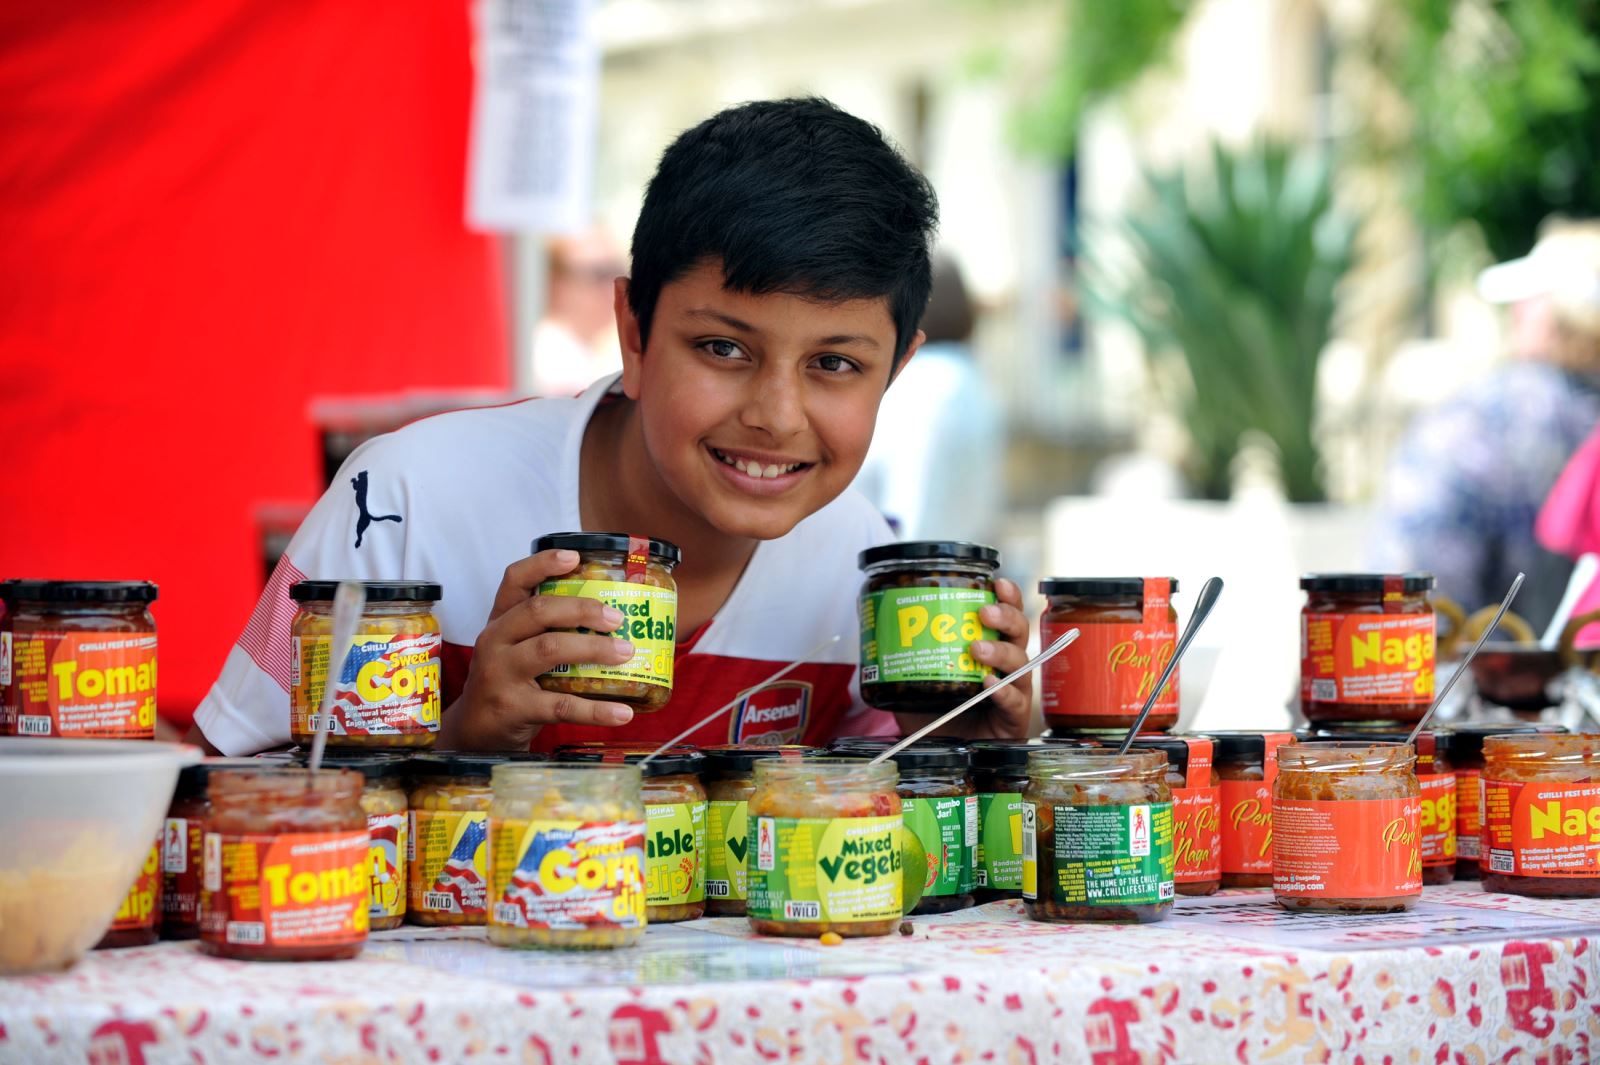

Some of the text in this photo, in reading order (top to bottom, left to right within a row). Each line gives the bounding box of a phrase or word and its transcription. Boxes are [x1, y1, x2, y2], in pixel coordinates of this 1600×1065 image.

[604, 599, 650, 617] ixed
[898, 605, 983, 647] Pea
[361, 643, 387, 653] CHILLI
[1351, 631, 1433, 670] Naga
[389, 650, 430, 669] Sweet
[356, 661, 440, 702] Corn
[744, 698, 801, 724] Arsenal
[24, 721, 49, 733] MILD
[345, 719, 366, 729] Enjoy
[367, 717, 383, 726] with
[1537, 790, 1563, 800] CHILLI
[936, 799, 961, 811] Jumbo
[937, 808, 952, 819] Jar!
[1529, 801, 1600, 843] Nag
[575, 840, 626, 859] Sweet
[841, 832, 892, 857] Mixed
[1173, 837, 1210, 869] Naga
[539, 849, 640, 894] Corn
[706, 884, 728, 896] WILD
[1086, 880, 1099, 888] THE
[1100, 879, 1118, 887] HOME
[1119, 878, 1126, 886] OF
[1127, 876, 1139, 885] THE
[1087, 882, 1157, 898] WWW.CHILLIFEST.NET
[1163, 887, 1173, 897] HO
[428, 897, 452, 909] WILD
[792, 907, 818, 918] WILD
